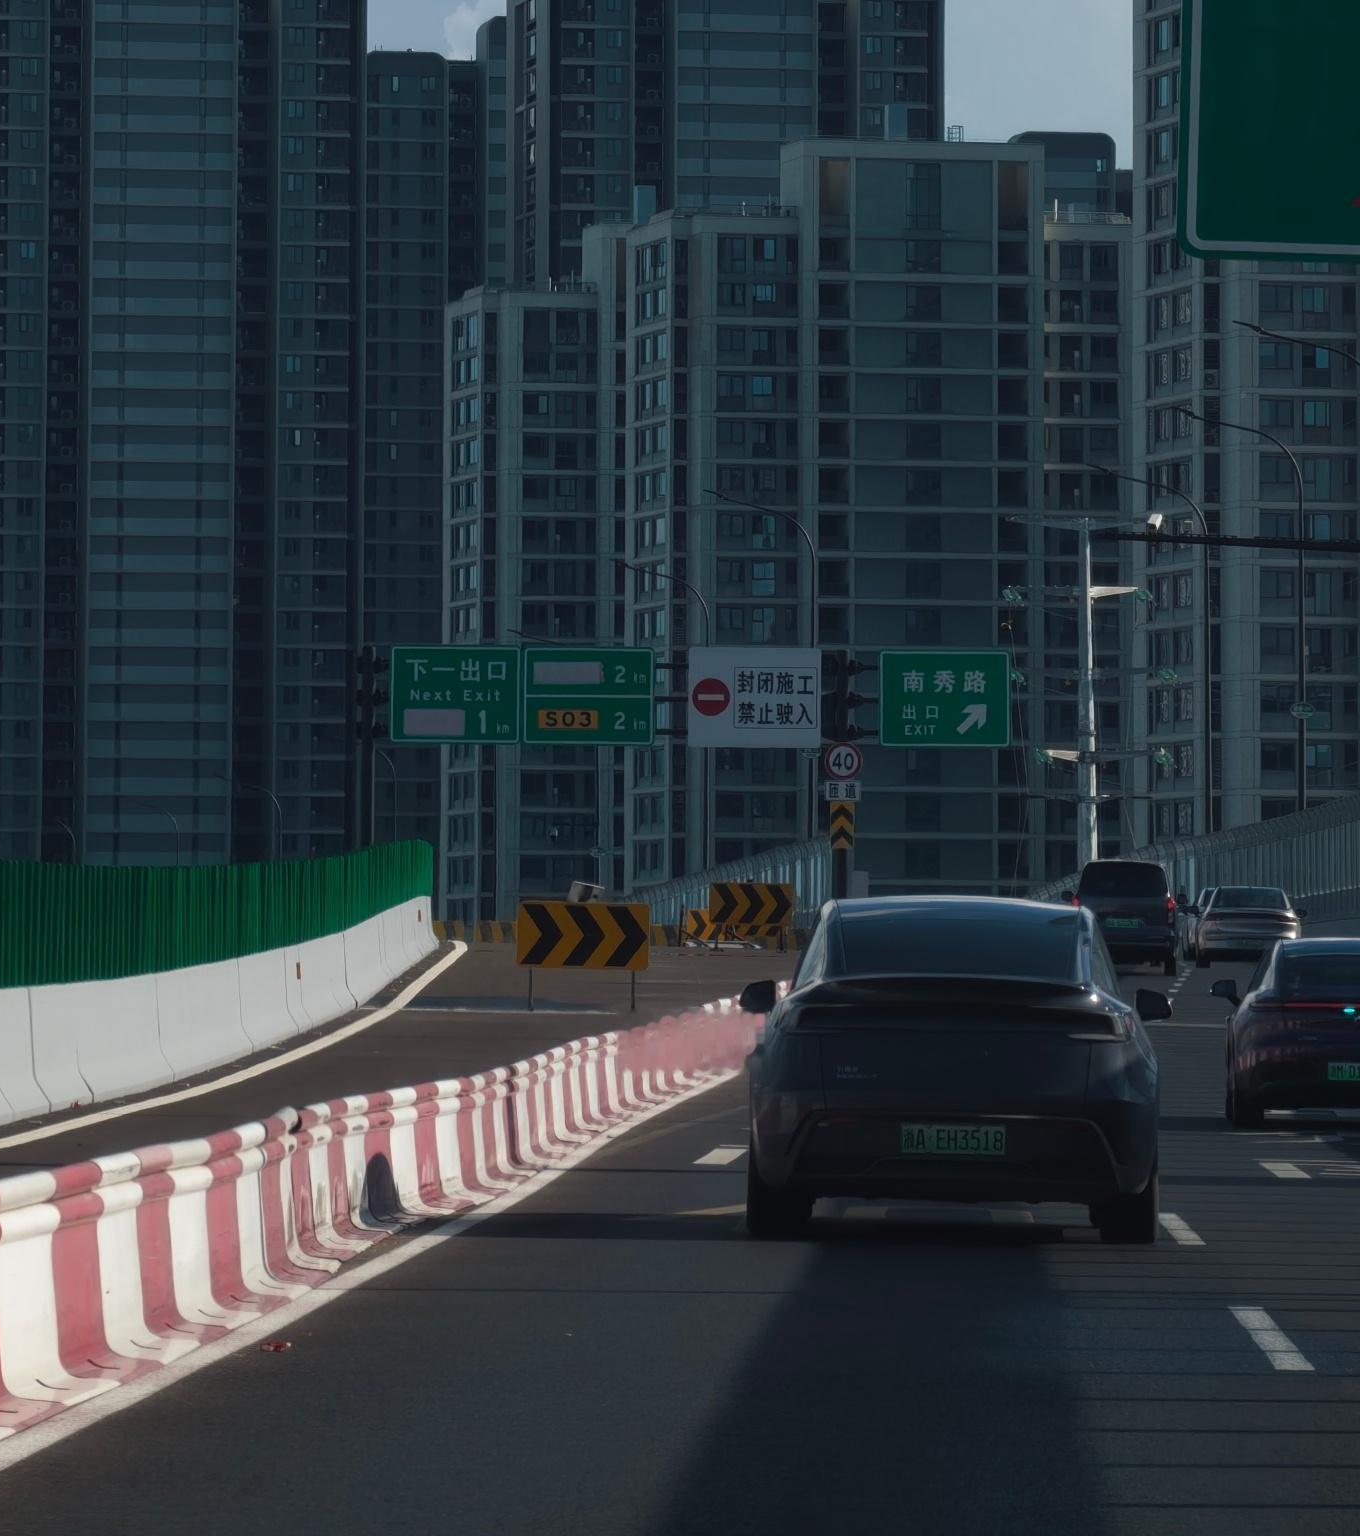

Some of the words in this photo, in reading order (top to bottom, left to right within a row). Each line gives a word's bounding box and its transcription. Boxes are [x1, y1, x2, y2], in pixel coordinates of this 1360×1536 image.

[404, 657, 507, 683] 下一出口
[613, 665, 626, 684] 2
[737, 670, 814, 696] 封闭施工
[901, 669, 987, 695] 南秀路
[409, 688, 452, 702] Next
[463, 688, 501, 702] Exit
[613, 711, 627, 731] 2
[737, 701, 814, 726] 禁止驶入
[902, 703, 939, 720] 出口
[478, 709, 488, 735] 1
[904, 724, 937, 736] EXIT
[832, 751, 855, 771] 40
[829, 783, 857, 799] 匝道
